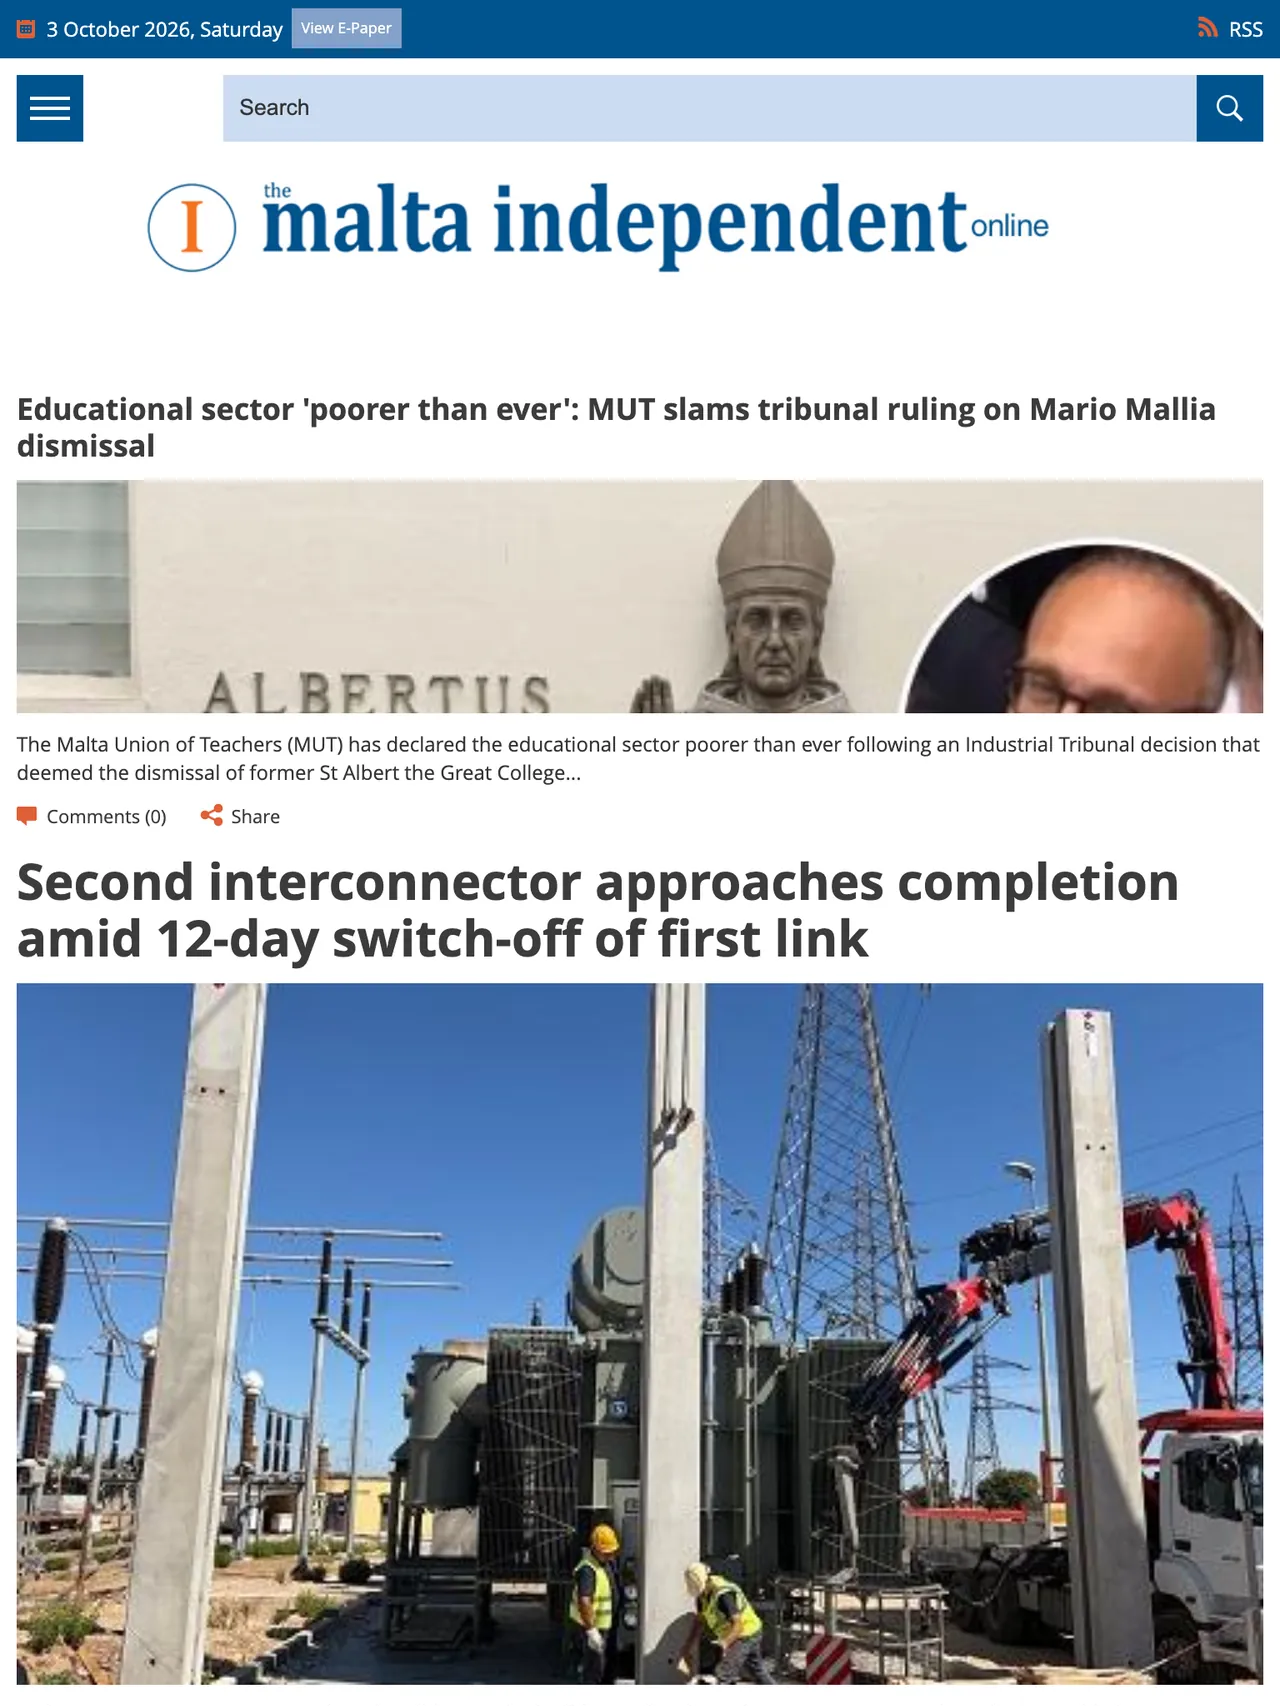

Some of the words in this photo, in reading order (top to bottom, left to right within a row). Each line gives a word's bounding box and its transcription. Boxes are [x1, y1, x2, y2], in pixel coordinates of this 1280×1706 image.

[47, 21, 58, 37] 3
[64, 21, 139, 37] October
[145, 21, 194, 40] 2026,
[201, 21, 283, 42] Saturday
[301, 22, 334, 34] View
[339, 22, 392, 37] E-Paper
[1231, 21, 1263, 37] RSS
[240, 98, 309, 116] Search
[264, 182, 291, 198] the
[262, 183, 472, 253] malta
[494, 183, 968, 272] independent
[971, 213, 1049, 237] online
[19, 396, 192, 421] Educational
[202, 399, 294, 421] sector
[304, 398, 410, 428] 'poorer
[418, 396, 487, 421] than
[497, 398, 578, 421] ever':
[589, 398, 655, 421] MUT
[664, 396, 749, 421] slams
[758, 396, 877, 421] tribunal
[889, 396, 975, 428] ruling
[984, 403, 1020, 420] on
[1031, 396, 1116, 421] Mario
[1127, 396, 1215, 421] Mallia
[18, 433, 154, 457] dismissal
[203, 670, 551, 713] ALBERTUS
[17, 764, 92, 780] deemed
[98, 764, 129, 780] the
[135, 764, 219, 780] dismissal
[226, 764, 245, 780] of
[249, 764, 314, 780] former
[320, 765, 338, 780] St
[343, 764, 399, 780] Albert
[404, 764, 434, 780] the
[441, 765, 492, 780] Great
[498, 764, 580, 785] College...
[47, 810, 140, 824] Comments
[145, 810, 166, 827] (0)
[232, 809, 280, 824] Share
[18, 861, 192, 901] Second
[211, 861, 581, 901] interconnector
[596, 861, 883, 912] approaches
[899, 861, 1177, 912] completion
[18, 918, 140, 958] amid
[158, 918, 320, 969] 12-day
[334, 917, 584, 957] switch-off
[596, 917, 647, 957] of
[658, 917, 760, 957] first
[778, 918, 869, 957] link
